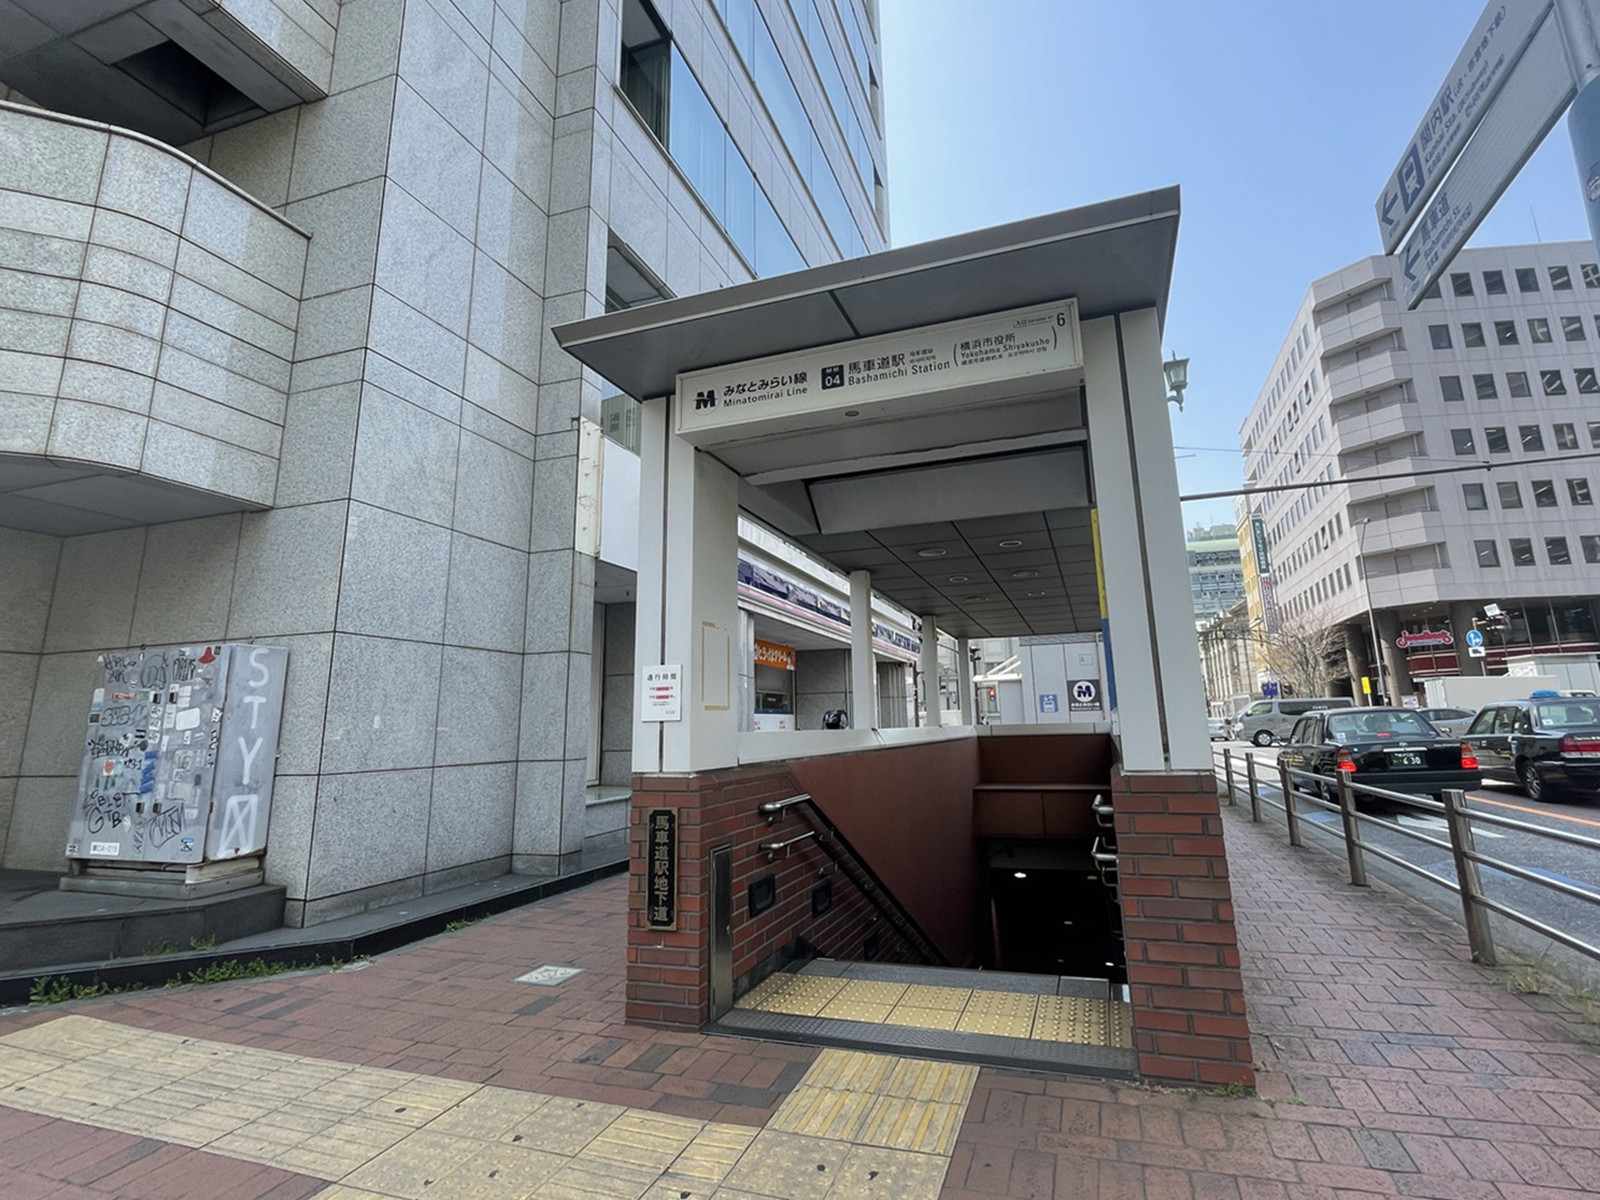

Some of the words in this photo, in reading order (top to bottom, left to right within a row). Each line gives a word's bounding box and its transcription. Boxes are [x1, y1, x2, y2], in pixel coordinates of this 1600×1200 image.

[1056, 312, 1066, 327] 6
[961, 347, 1000, 359] Yokohama
[1003, 338, 1050, 351] Shiyakusho
[848, 353, 906, 375] 馬車道駅
[848, 367, 908, 386] Bashamichi
[911, 361, 951, 376] Station
[723, 371, 808, 398] みなとみらい線
[825, 375, 841, 387] 04
[723, 390, 784, 408] Minatomirai
[786, 386, 808, 397] Line
[654, 815, 670, 922] 馬車道駅地下道
